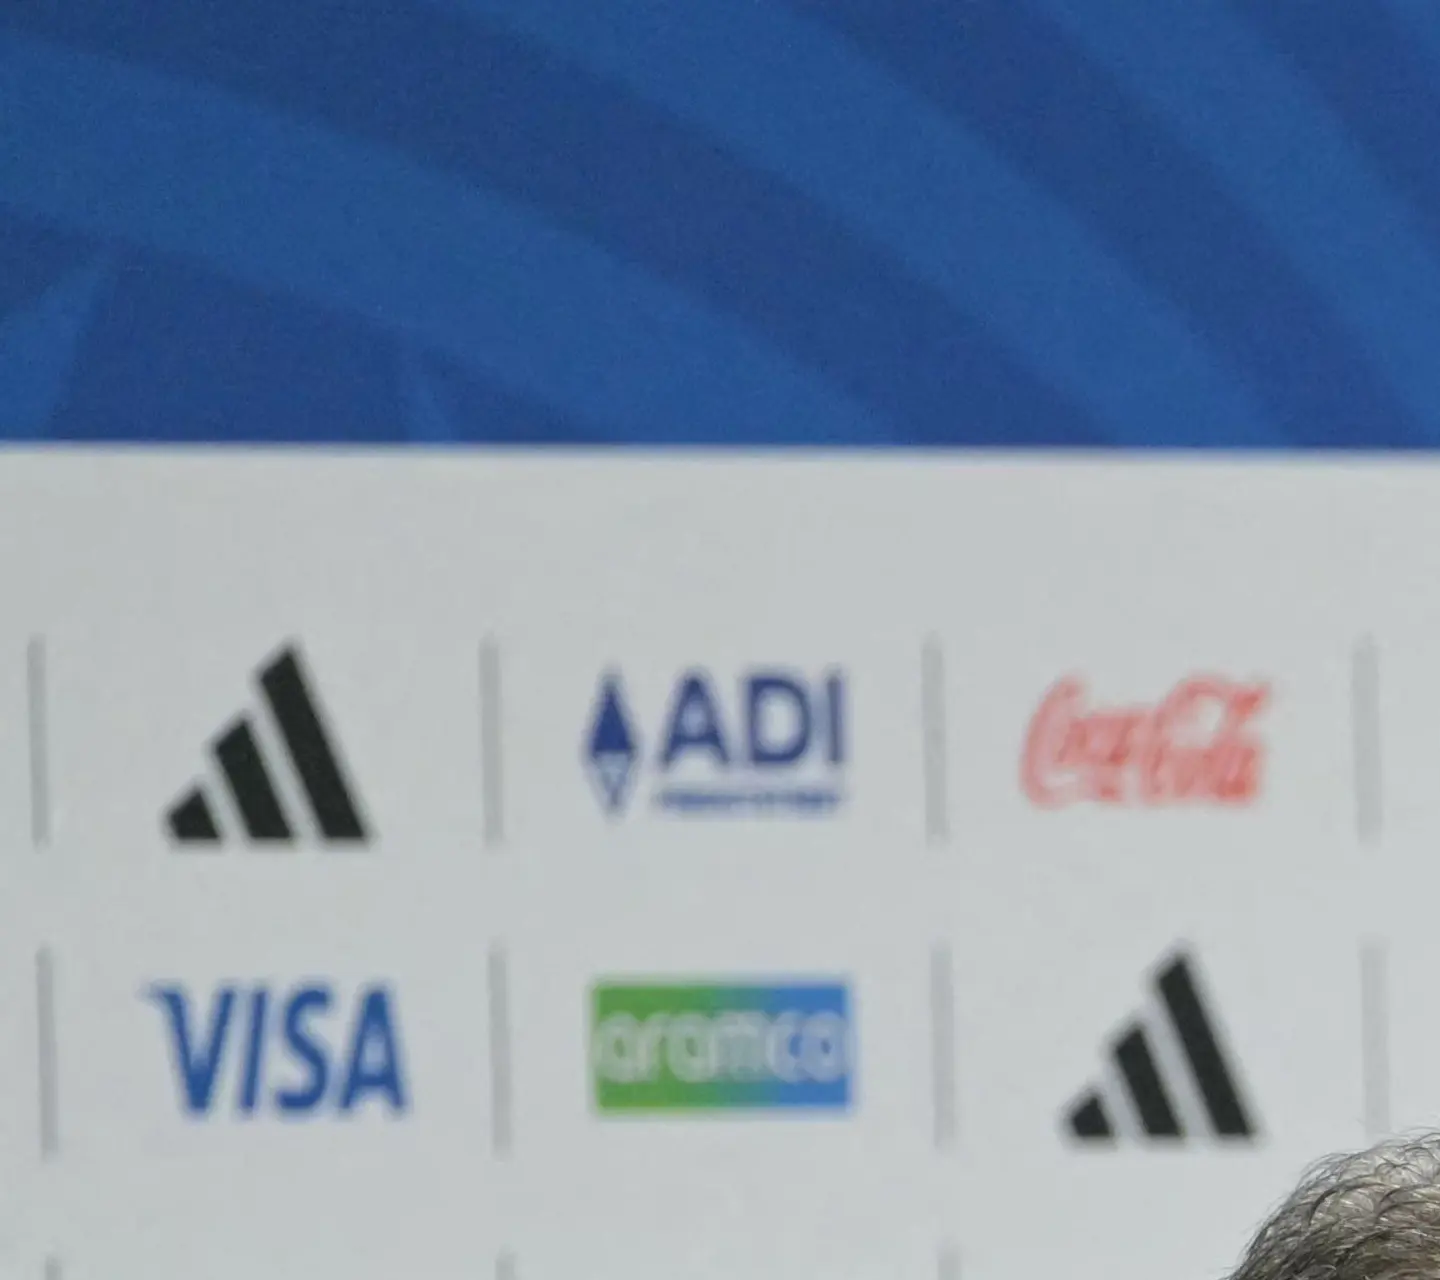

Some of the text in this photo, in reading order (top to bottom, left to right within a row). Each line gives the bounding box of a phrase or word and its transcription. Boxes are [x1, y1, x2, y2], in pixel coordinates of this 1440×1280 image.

[657, 671, 845, 771] ADI
[147, 984, 408, 1116] VISA
[598, 1009, 852, 1082] aramco
